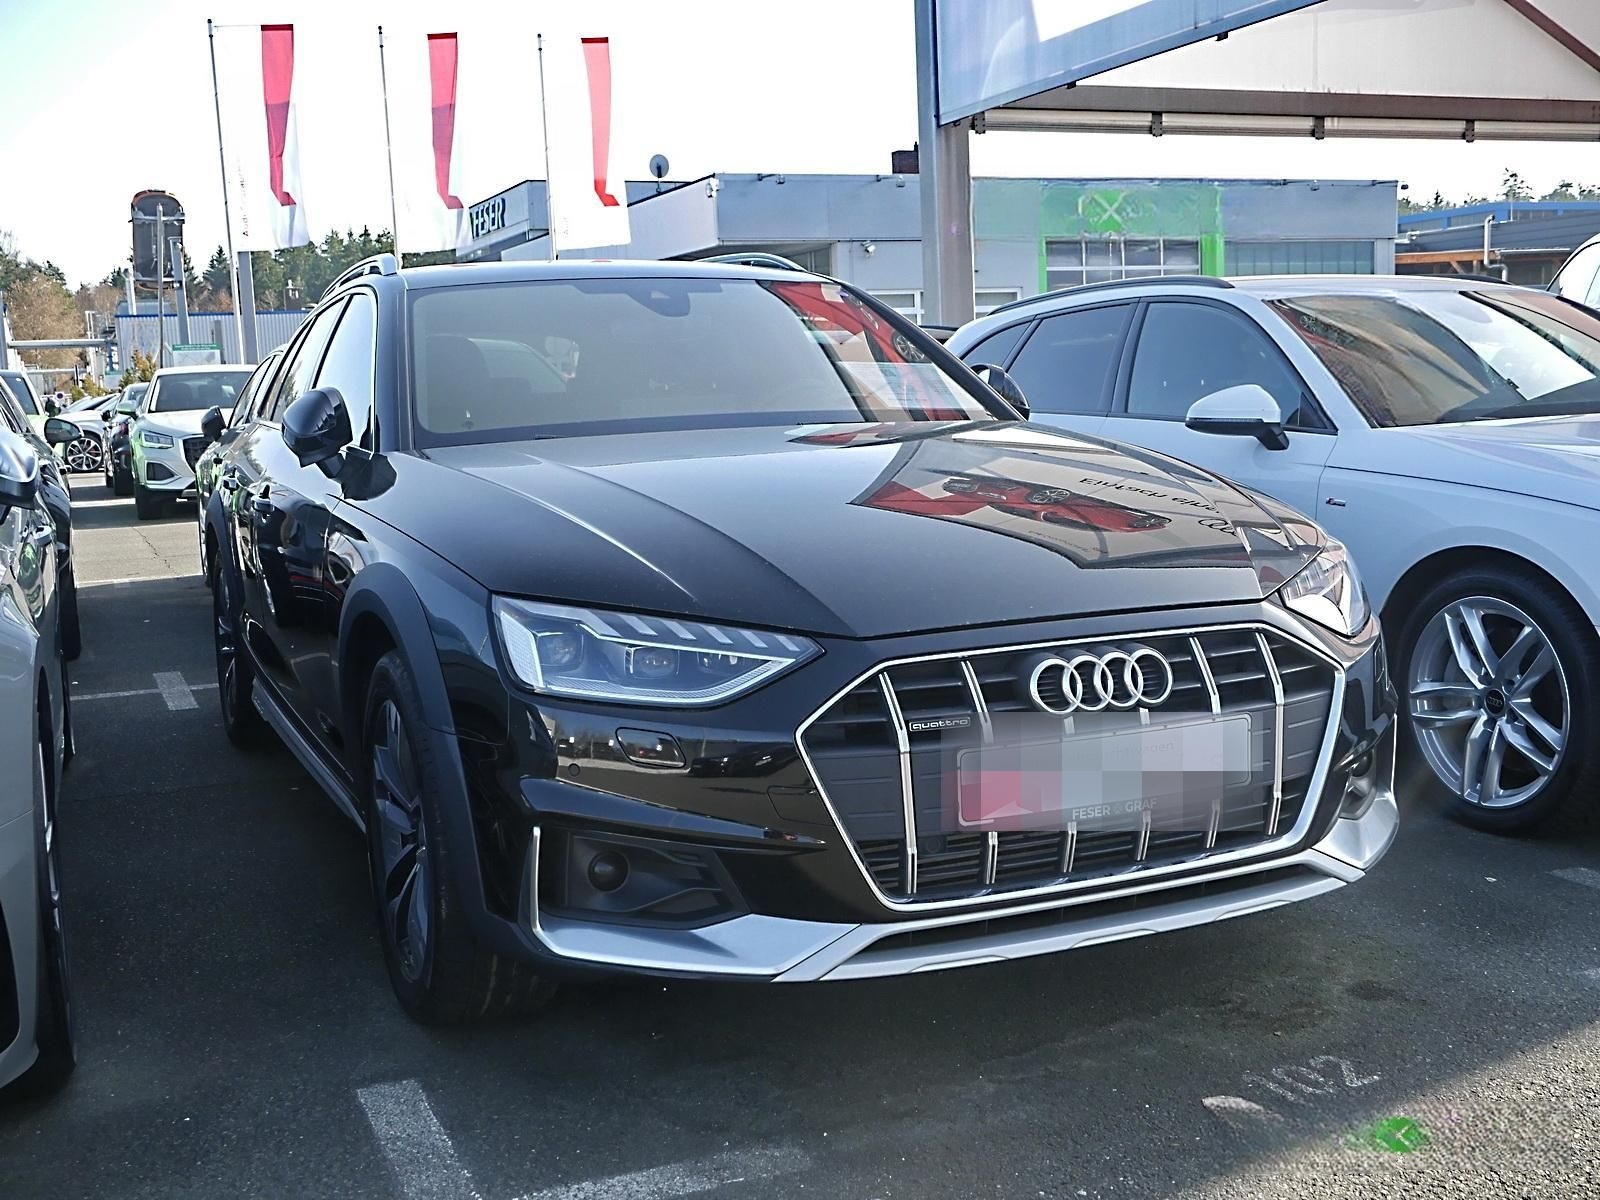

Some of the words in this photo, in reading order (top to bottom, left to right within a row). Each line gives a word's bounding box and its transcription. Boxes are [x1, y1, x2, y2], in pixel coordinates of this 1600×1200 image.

[471, 197, 506, 240] FESER
[912, 719, 968, 730] quattro
[1072, 804, 1111, 820] FESER
[1125, 798, 1157, 813] GRAF
